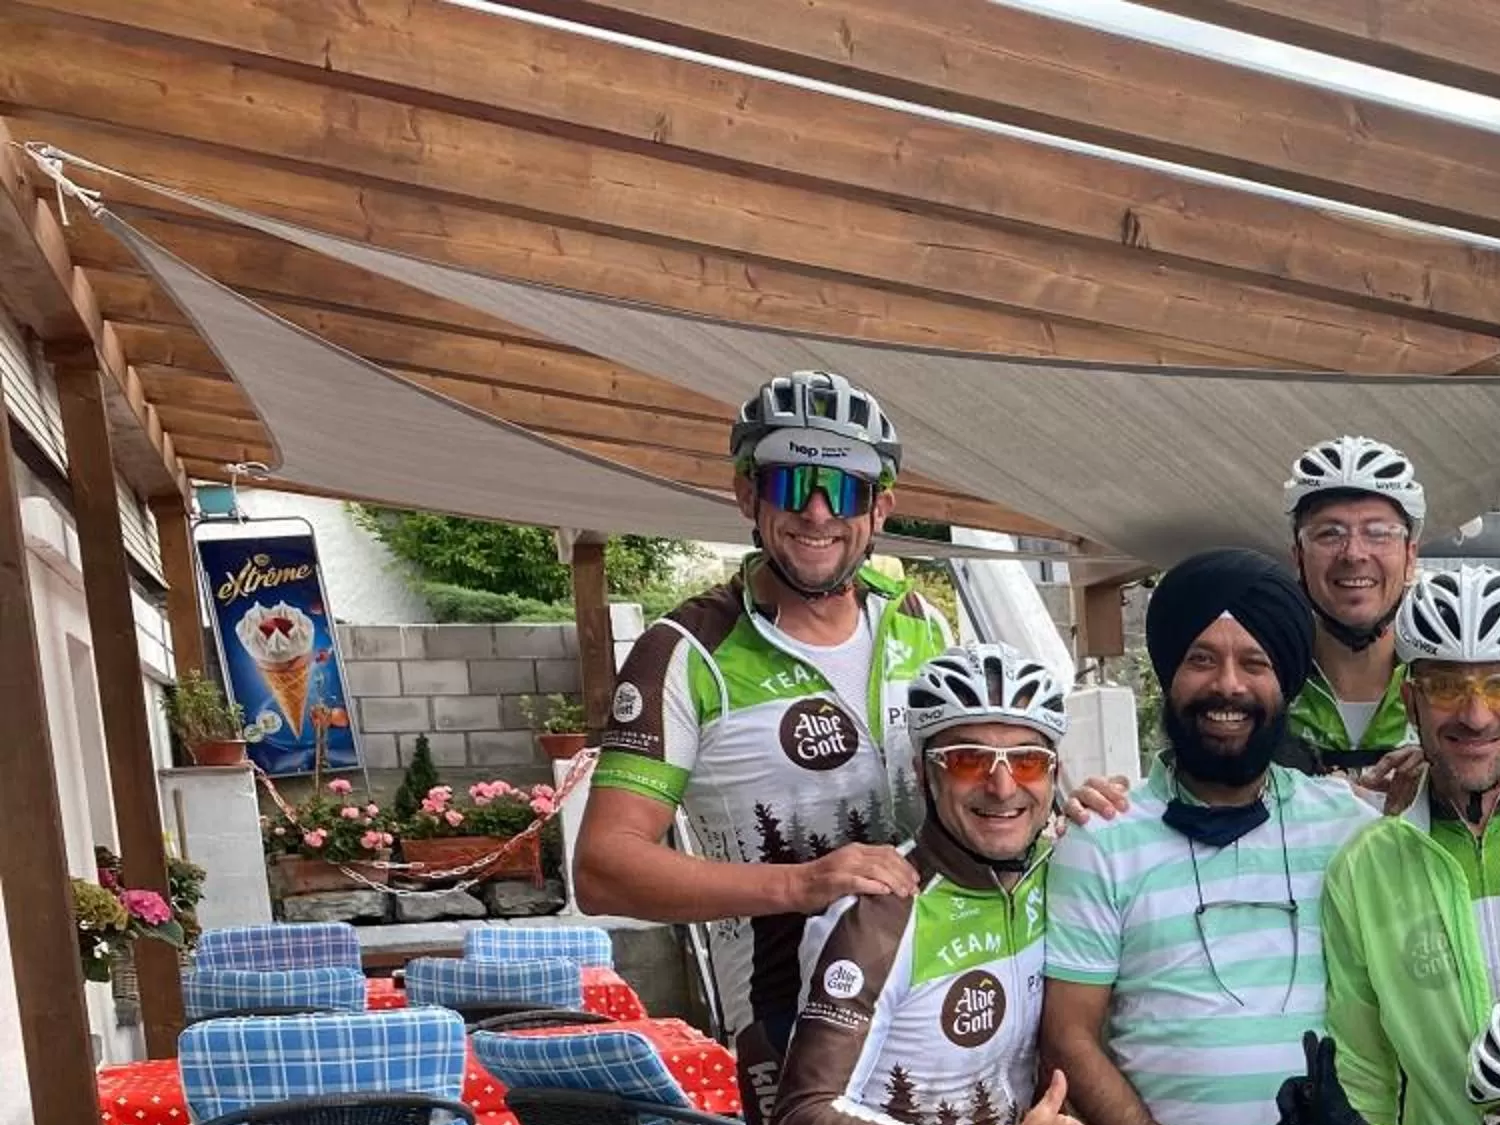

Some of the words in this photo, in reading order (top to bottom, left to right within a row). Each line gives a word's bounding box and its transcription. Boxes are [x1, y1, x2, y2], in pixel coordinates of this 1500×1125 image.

[760, 662, 819, 696] TEA
[793, 712, 842, 739] Alde
[796, 731, 849, 761] Gott
[936, 930, 1002, 967] TEAM
[953, 986, 998, 1013] Alde
[952, 1007, 996, 1035] Gott
